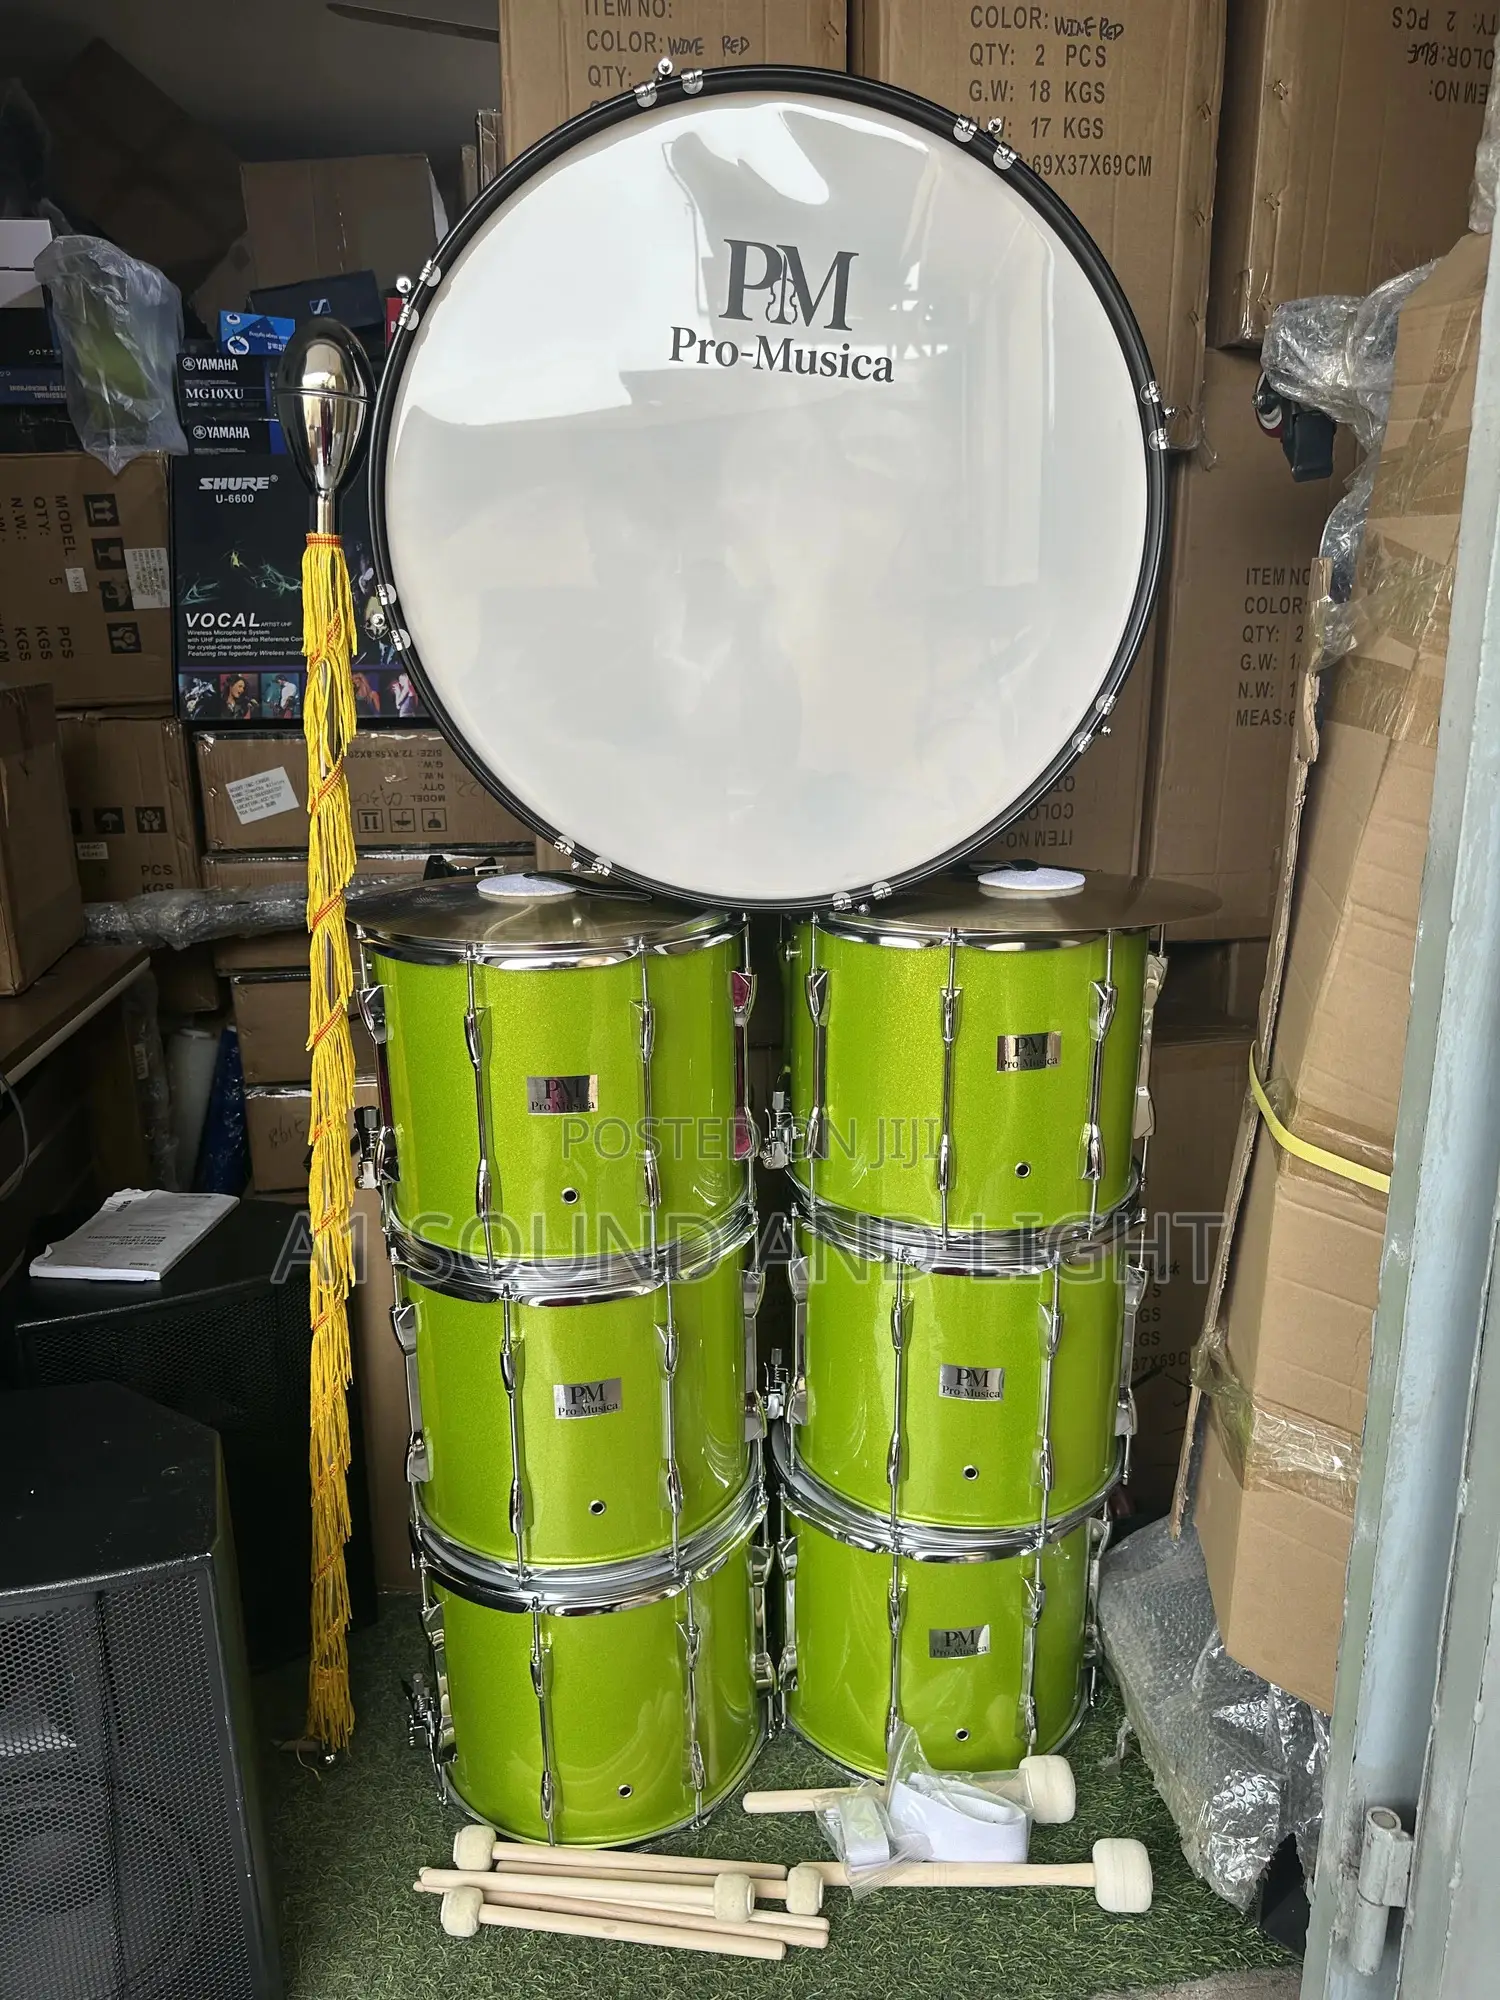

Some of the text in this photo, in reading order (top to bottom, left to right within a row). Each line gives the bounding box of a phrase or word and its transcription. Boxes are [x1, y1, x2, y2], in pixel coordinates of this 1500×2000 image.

[970, 5, 1049, 30] COLOR:
[1392, 6, 1497, 35] TY: 2 PCS
[1099, 17, 1124, 41] RED
[586, 29, 663, 53] COLOR:
[722, 35, 750, 57] RED
[969, 42, 1107, 68] QTY: 2 PCS
[1441, 45, 1495, 70] OLOR:
[588, 65, 632, 88] QTY:
[969, 79, 1105, 104] G.W: 18 KGS
[1031, 116, 1052, 139] 17
[1063, 117, 1104, 140] KGS
[719, 238, 859, 331] PM
[668, 326, 895, 383] Pro-Musica
[195, 359, 239, 371] YAMAHA
[185, 388, 244, 400] MG10XU
[206, 426, 251, 439] YAMAHA
[215, 494, 255, 504] U-6600
[33, 495, 74, 659] QTY: 5 PCS
[1246, 567, 1285, 586] ITEM
[185, 612, 260, 628] VOCAL
[213, 629, 247, 637] Microphone
[248, 629, 270, 637] System
[1242, 625, 1304, 643] QTY: 2
[14, 627, 31, 662] KGS
[35, 625, 53, 661] KGS
[228, 650, 258, 658] legendary
[1240, 653, 1277, 671] G.W:
[1238, 682, 1274, 699] N.W:
[416, 749, 443, 757] SIZE:
[1034, 830, 1073, 847] ITEM
[140, 864, 173, 876] PCS
[1000, 1057, 1058, 1069] Pro-Musica
[531, 1101, 596, 1111] Pro-Musica
[1136, 1308, 1161, 1324] GS
[1135, 1331, 1161, 1349] GS
[956, 1367, 990, 1388] PM
[570, 1383, 605, 1405] PM
[942, 1385, 1001, 1398] Pro-Musica
[558, 1403, 618, 1416] Pro-Musica
[944, 1629, 976, 1647] PM
[933, 1646, 987, 1657] Pro-Musica
